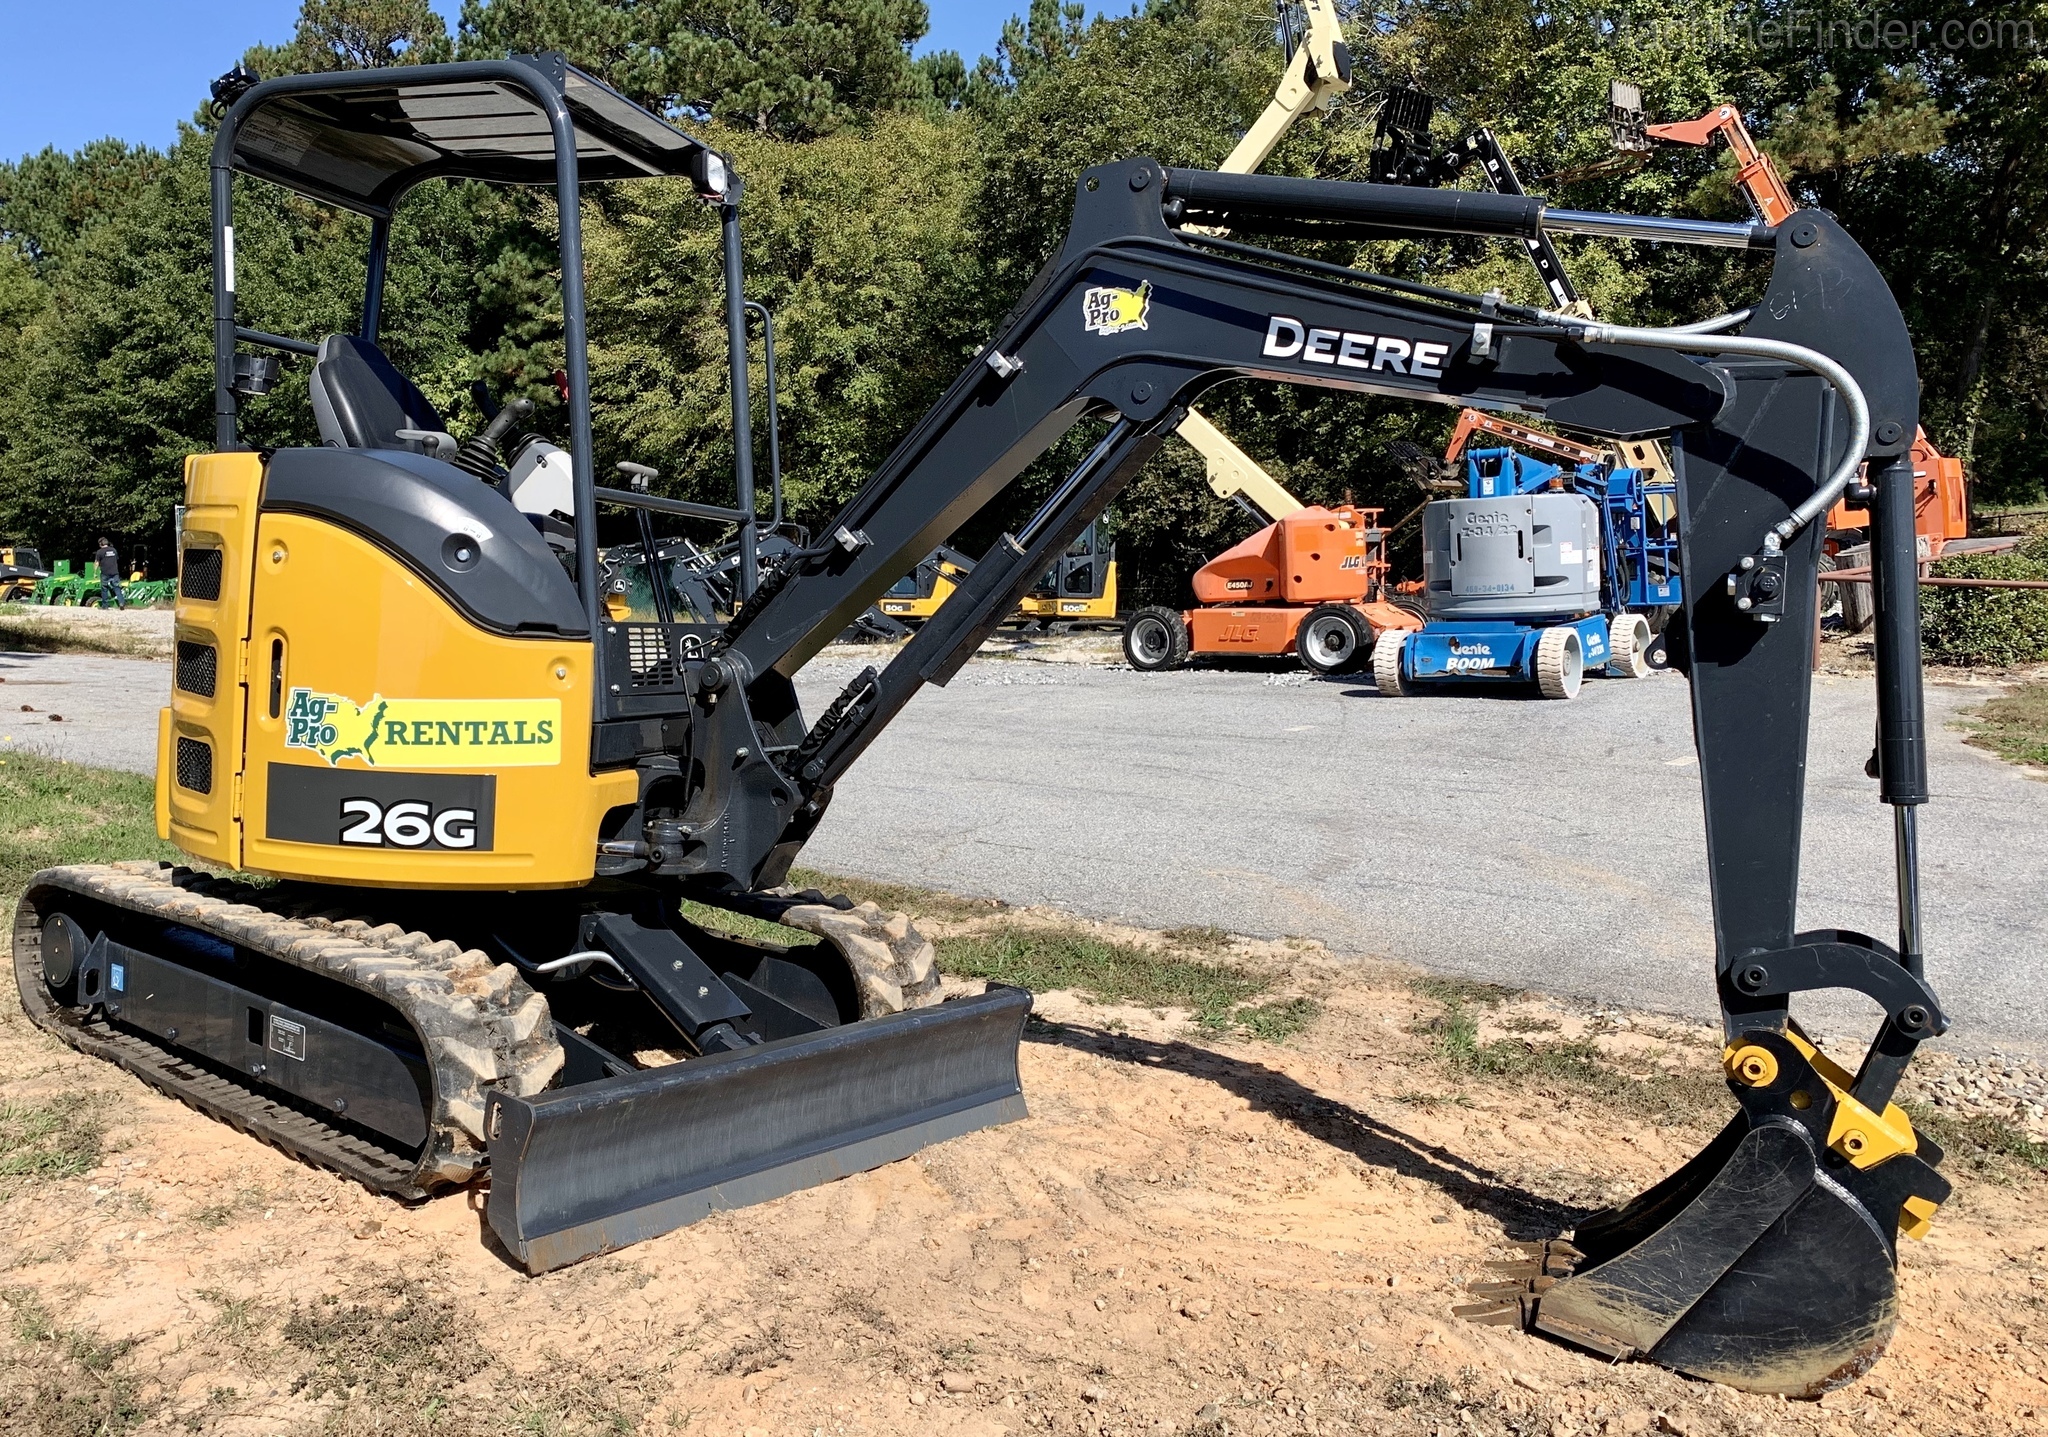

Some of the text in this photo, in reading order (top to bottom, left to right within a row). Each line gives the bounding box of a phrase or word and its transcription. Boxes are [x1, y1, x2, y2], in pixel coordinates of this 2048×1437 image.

[1764, 196, 1775, 206] A
[1540, 259, 1549, 269] D
[1088, 292, 1118, 310] Ag-
[1089, 309, 1120, 326] Pro
[1263, 316, 1449, 379] DEERE
[1466, 511, 1509, 525] Genie
[1461, 525, 1518, 538] Z-34/22
[1341, 555, 1360, 569] JLG
[1218, 625, 1260, 642] JLG
[1450, 643, 1491, 655] Genie
[1446, 657, 1495, 670] BOOM
[290, 692, 337, 721] Ag-
[289, 718, 338, 745] Pro
[384, 720, 554, 745] RENTALS
[342, 800, 475, 848] 26G
